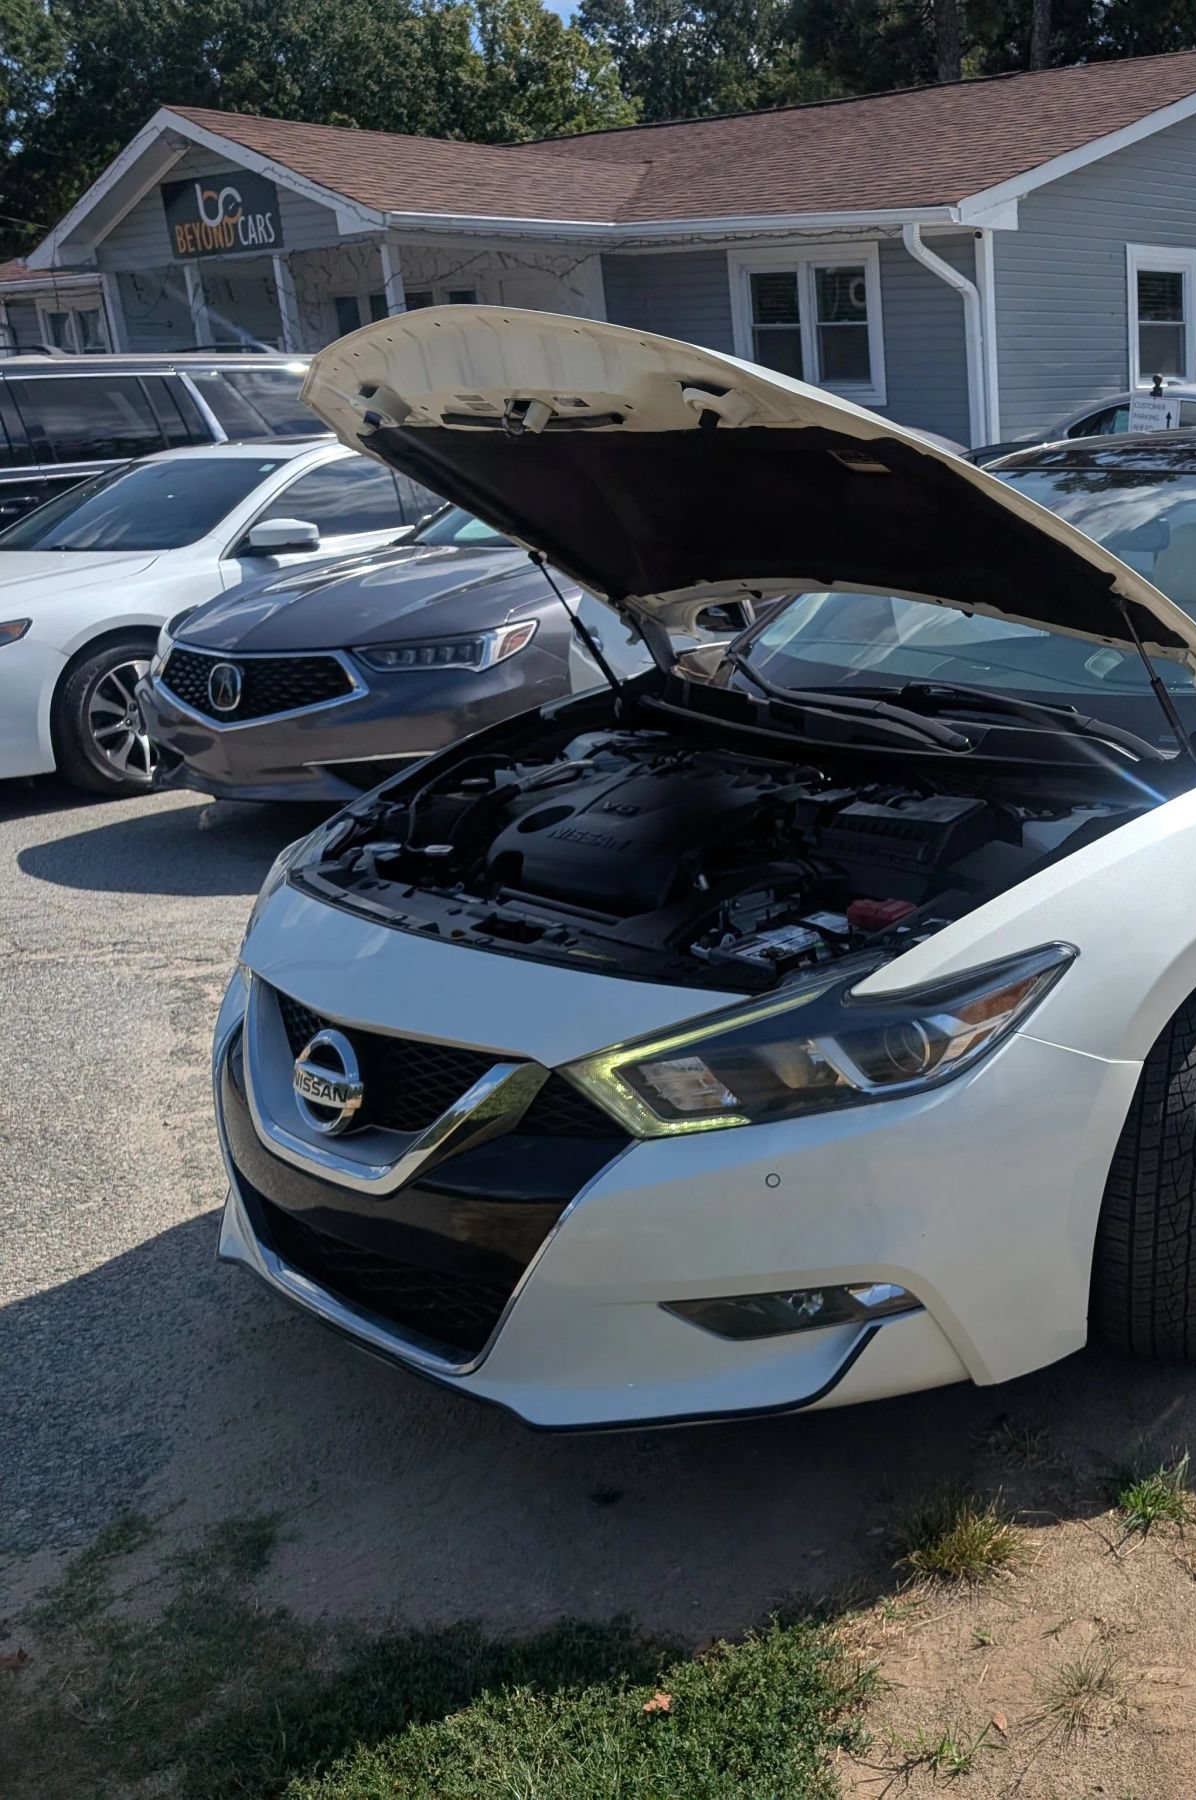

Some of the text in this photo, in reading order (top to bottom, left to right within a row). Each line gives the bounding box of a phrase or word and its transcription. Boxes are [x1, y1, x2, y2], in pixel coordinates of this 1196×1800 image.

[174, 212, 276, 254] BEYOND CARS
[547, 828, 632, 852] NISSAN
[294, 1069, 349, 1103] NISSAN
